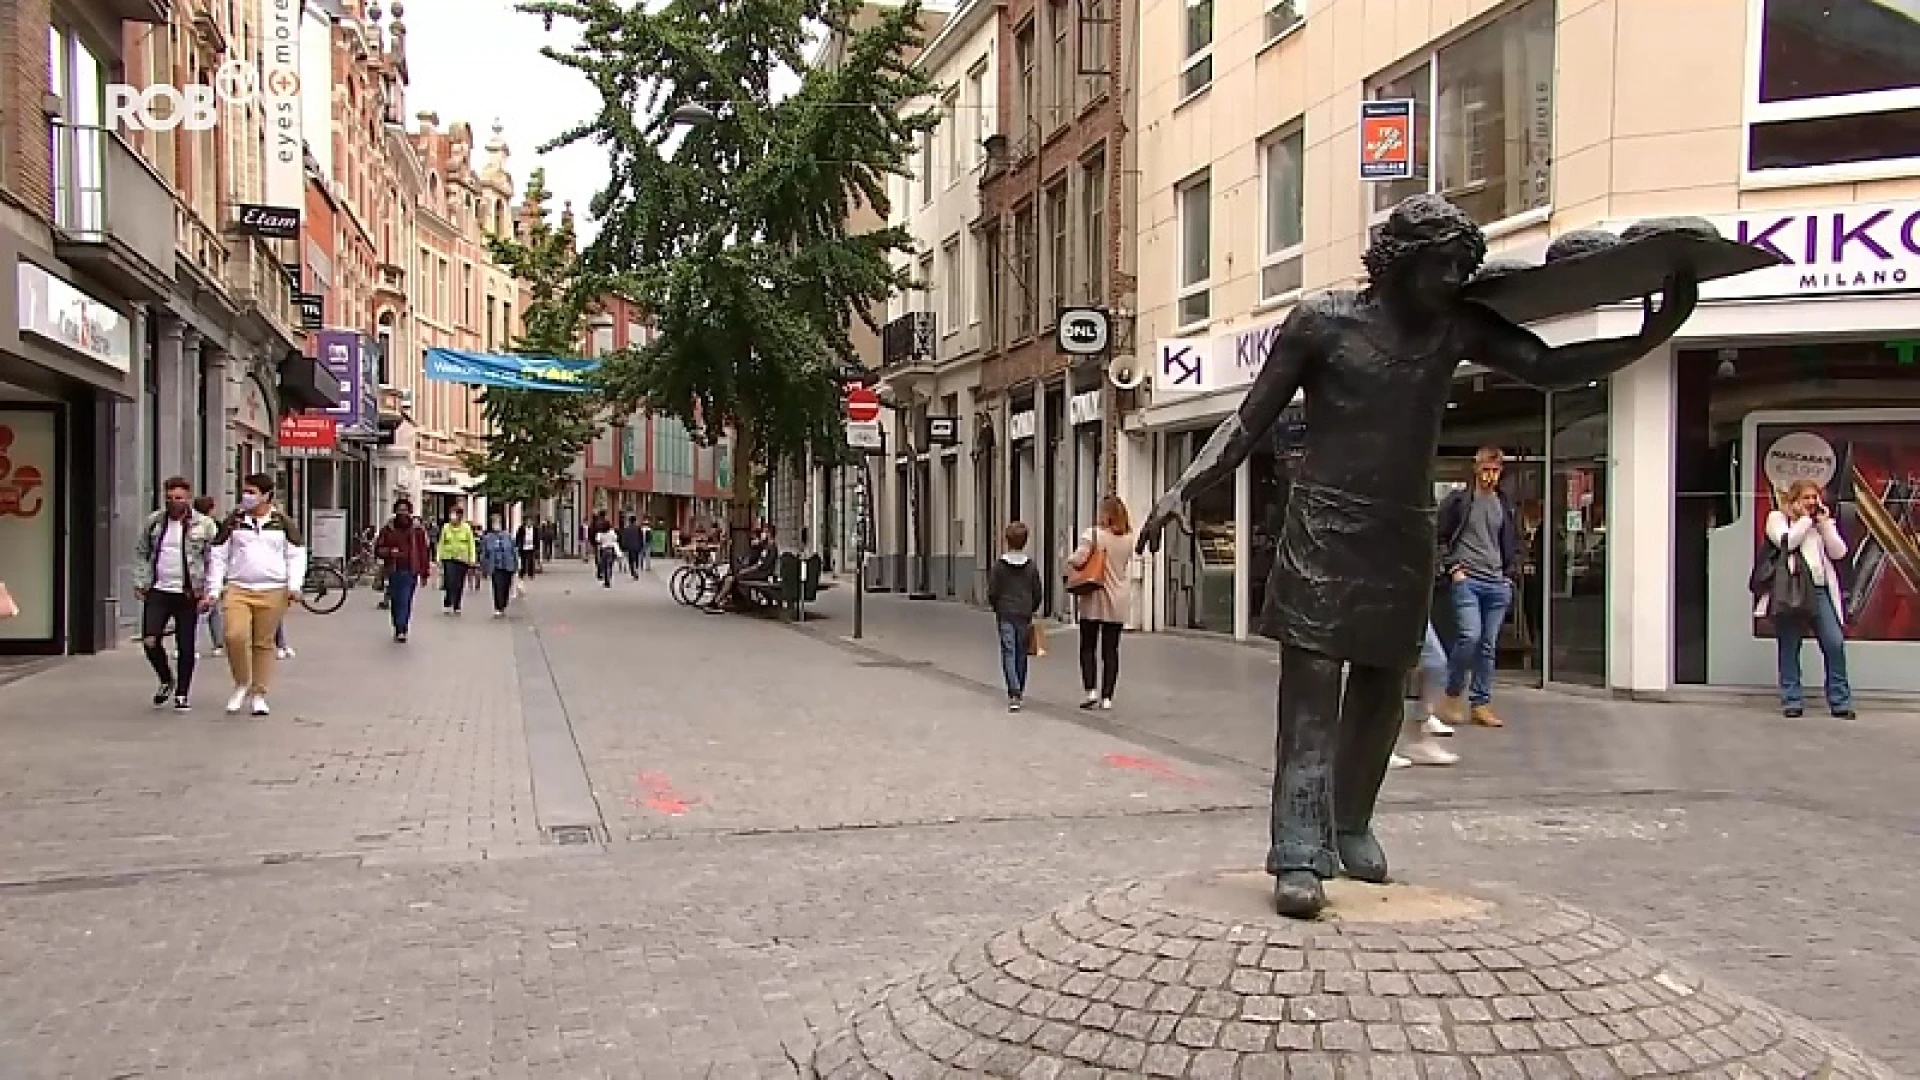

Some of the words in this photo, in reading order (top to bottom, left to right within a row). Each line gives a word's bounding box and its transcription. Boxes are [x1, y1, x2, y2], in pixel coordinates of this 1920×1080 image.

[277, 102, 298, 163] eyes
[244, 208, 296, 229] Etam
[1799, 268, 1907, 289] MILANO
